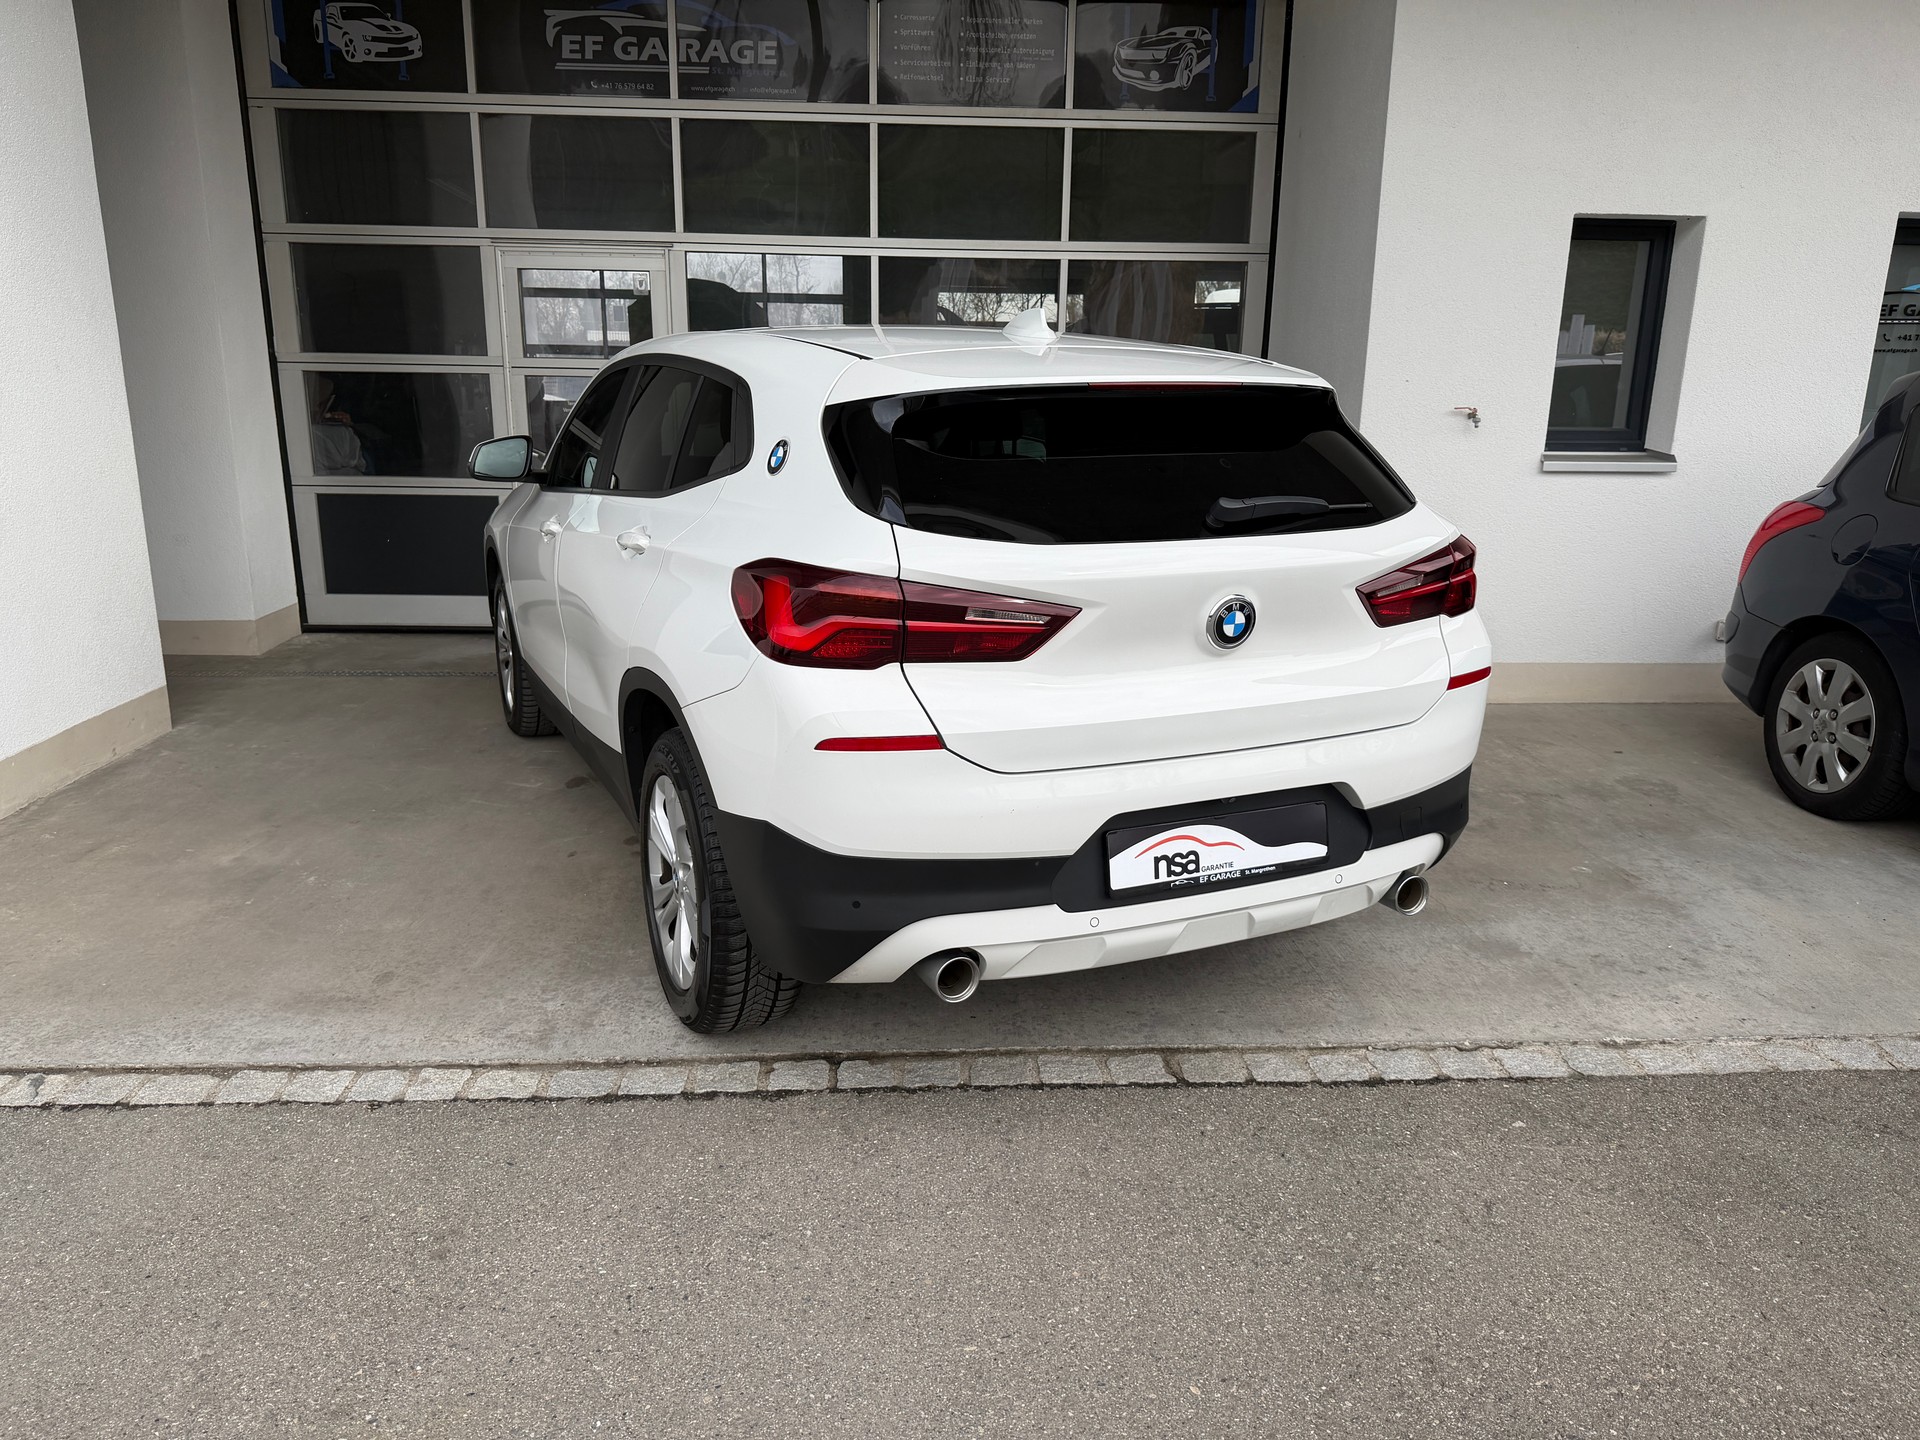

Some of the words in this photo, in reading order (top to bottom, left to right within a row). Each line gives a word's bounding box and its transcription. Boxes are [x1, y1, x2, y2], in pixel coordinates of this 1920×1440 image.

[561, 34, 604, 60] EF
[613, 36, 777, 65] GARAGE
[601, 82, 613, 90] +41
[615, 82, 623, 90] 76
[624, 82, 636, 91] 579
[637, 82, 646, 91] 64
[646, 83, 655, 91] 82
[1903, 304, 1920, 317] G
[1153, 850, 1200, 880] nsa
[1201, 861, 1234, 873] GARANTIE
[1199, 874, 1209, 883] EF
[1209, 869, 1242, 882] GARAGE
